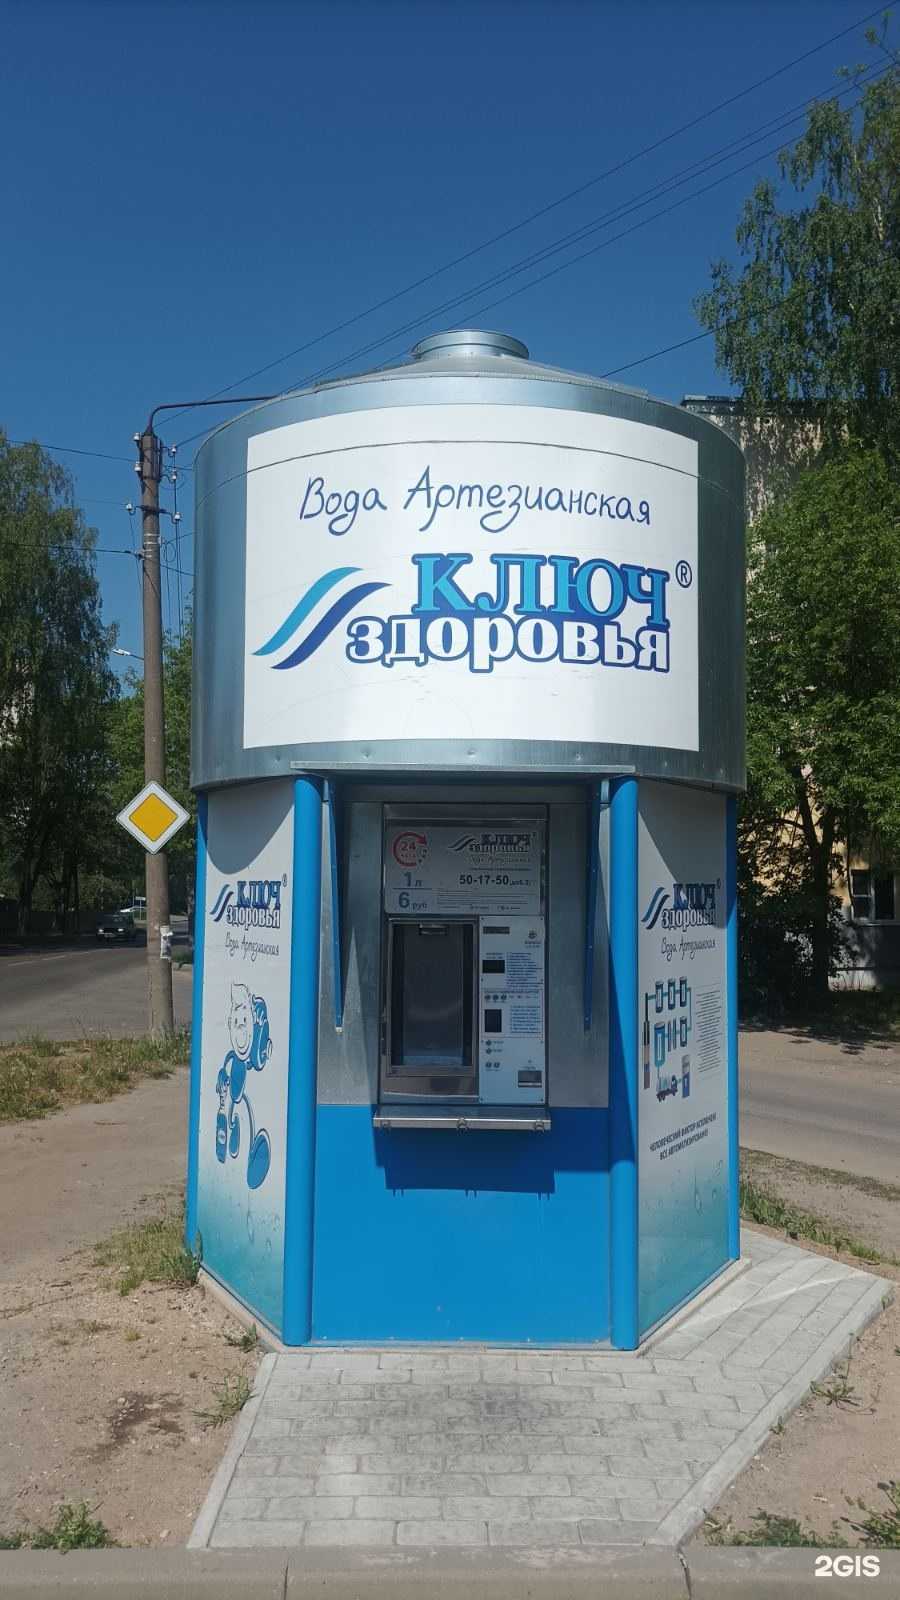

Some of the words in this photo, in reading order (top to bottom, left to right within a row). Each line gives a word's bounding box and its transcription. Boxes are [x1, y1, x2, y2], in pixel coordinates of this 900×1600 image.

[299, 476, 387, 536] Вода
[403, 465, 651, 533] Артезианская
[411, 552, 671, 629] КЛЮЧ
[399, 841, 416, 851] 24
[403, 872, 413, 887] 1
[459, 874, 509, 886] 50-17-50
[237, 880, 281, 910] КЛЮЧ
[398, 891, 410, 908] 6
